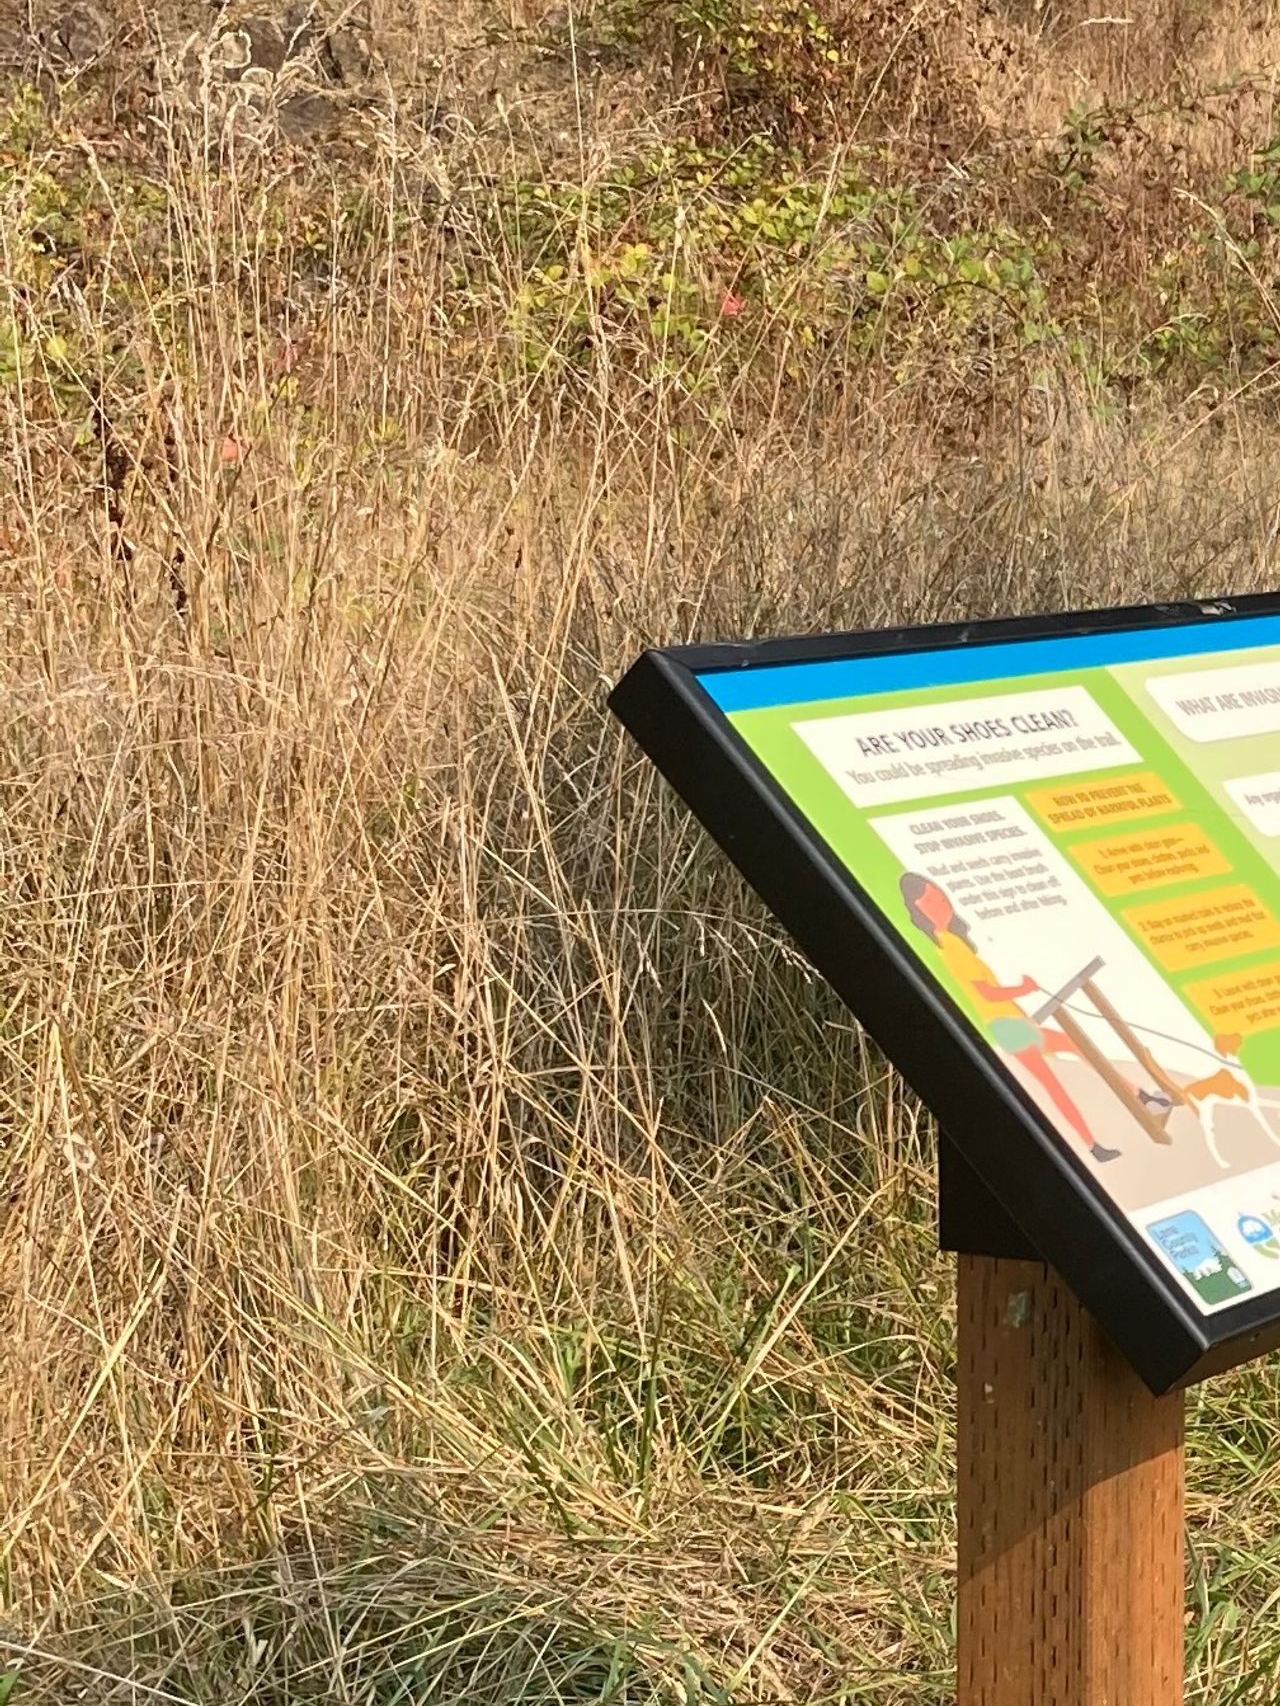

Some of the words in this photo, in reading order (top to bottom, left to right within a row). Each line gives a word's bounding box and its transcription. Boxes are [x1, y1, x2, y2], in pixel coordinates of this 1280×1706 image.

[1175, 696, 1218, 716] WHAT
[1214, 692, 1244, 711] ARE
[856, 734, 897, 756] ARE
[893, 726, 954, 750] YOUR
[948, 718, 1012, 743] SHOES
[1010, 709, 1078, 734] CLEAN?
[845, 769, 876, 785] You
[874, 762, 910, 782] could
[903, 761, 927, 777] be
[924, 753, 984, 776] spreading
[975, 747, 1024, 765] invasive
[1021, 741, 1064, 761] species
[1060, 740, 1078, 753] on
[1074, 735, 1097, 750] the
[1093, 730, 1121, 747] trail.
[908, 820, 945, 835] CLEAN
[941, 815, 972, 829] YOUR
[968, 809, 1006, 825] SHOES.
[913, 839, 941, 855] STOP
[939, 831, 987, 849] INVASIVE
[984, 825, 1027, 842] SPECIES.
